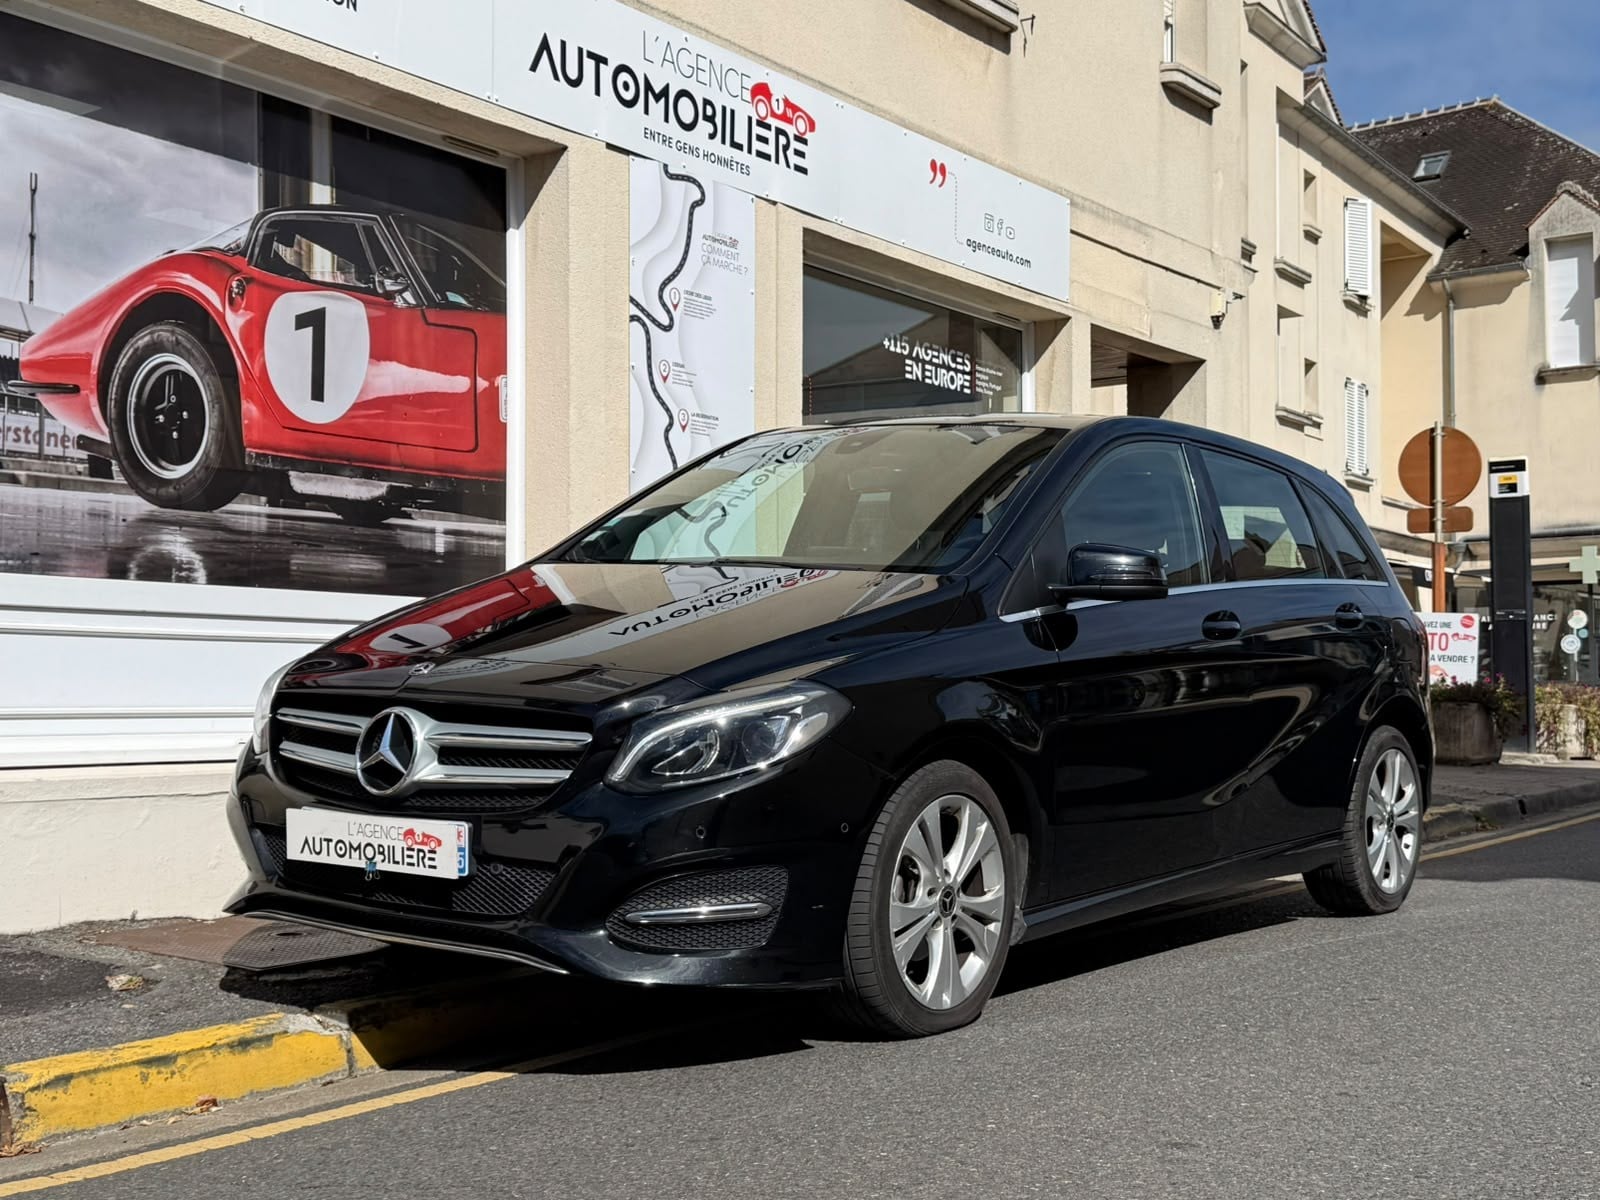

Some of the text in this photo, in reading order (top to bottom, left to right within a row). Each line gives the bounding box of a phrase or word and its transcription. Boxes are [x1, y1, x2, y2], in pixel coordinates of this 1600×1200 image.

[642, 30, 751, 104] L'AGENCE
[643, 127, 751, 176] ENTRE GENS HONNÊTES
[701, 243, 739, 261] COMMENT
[966, 238, 1032, 268] agenceauto.com
[712, 257, 743, 275] MARCHE
[294, 306, 327, 404] 1
[883, 333, 910, 356] +115
[912, 341, 972, 372] AGENCES
[662, 363, 668, 373] 2
[905, 359, 923, 381] EN
[924, 364, 972, 394] EUROPE
[681, 412, 687, 422] 3
[1437, 654, 1468, 663] VENDRE
[347, 821, 404, 841] L'AGENCE
